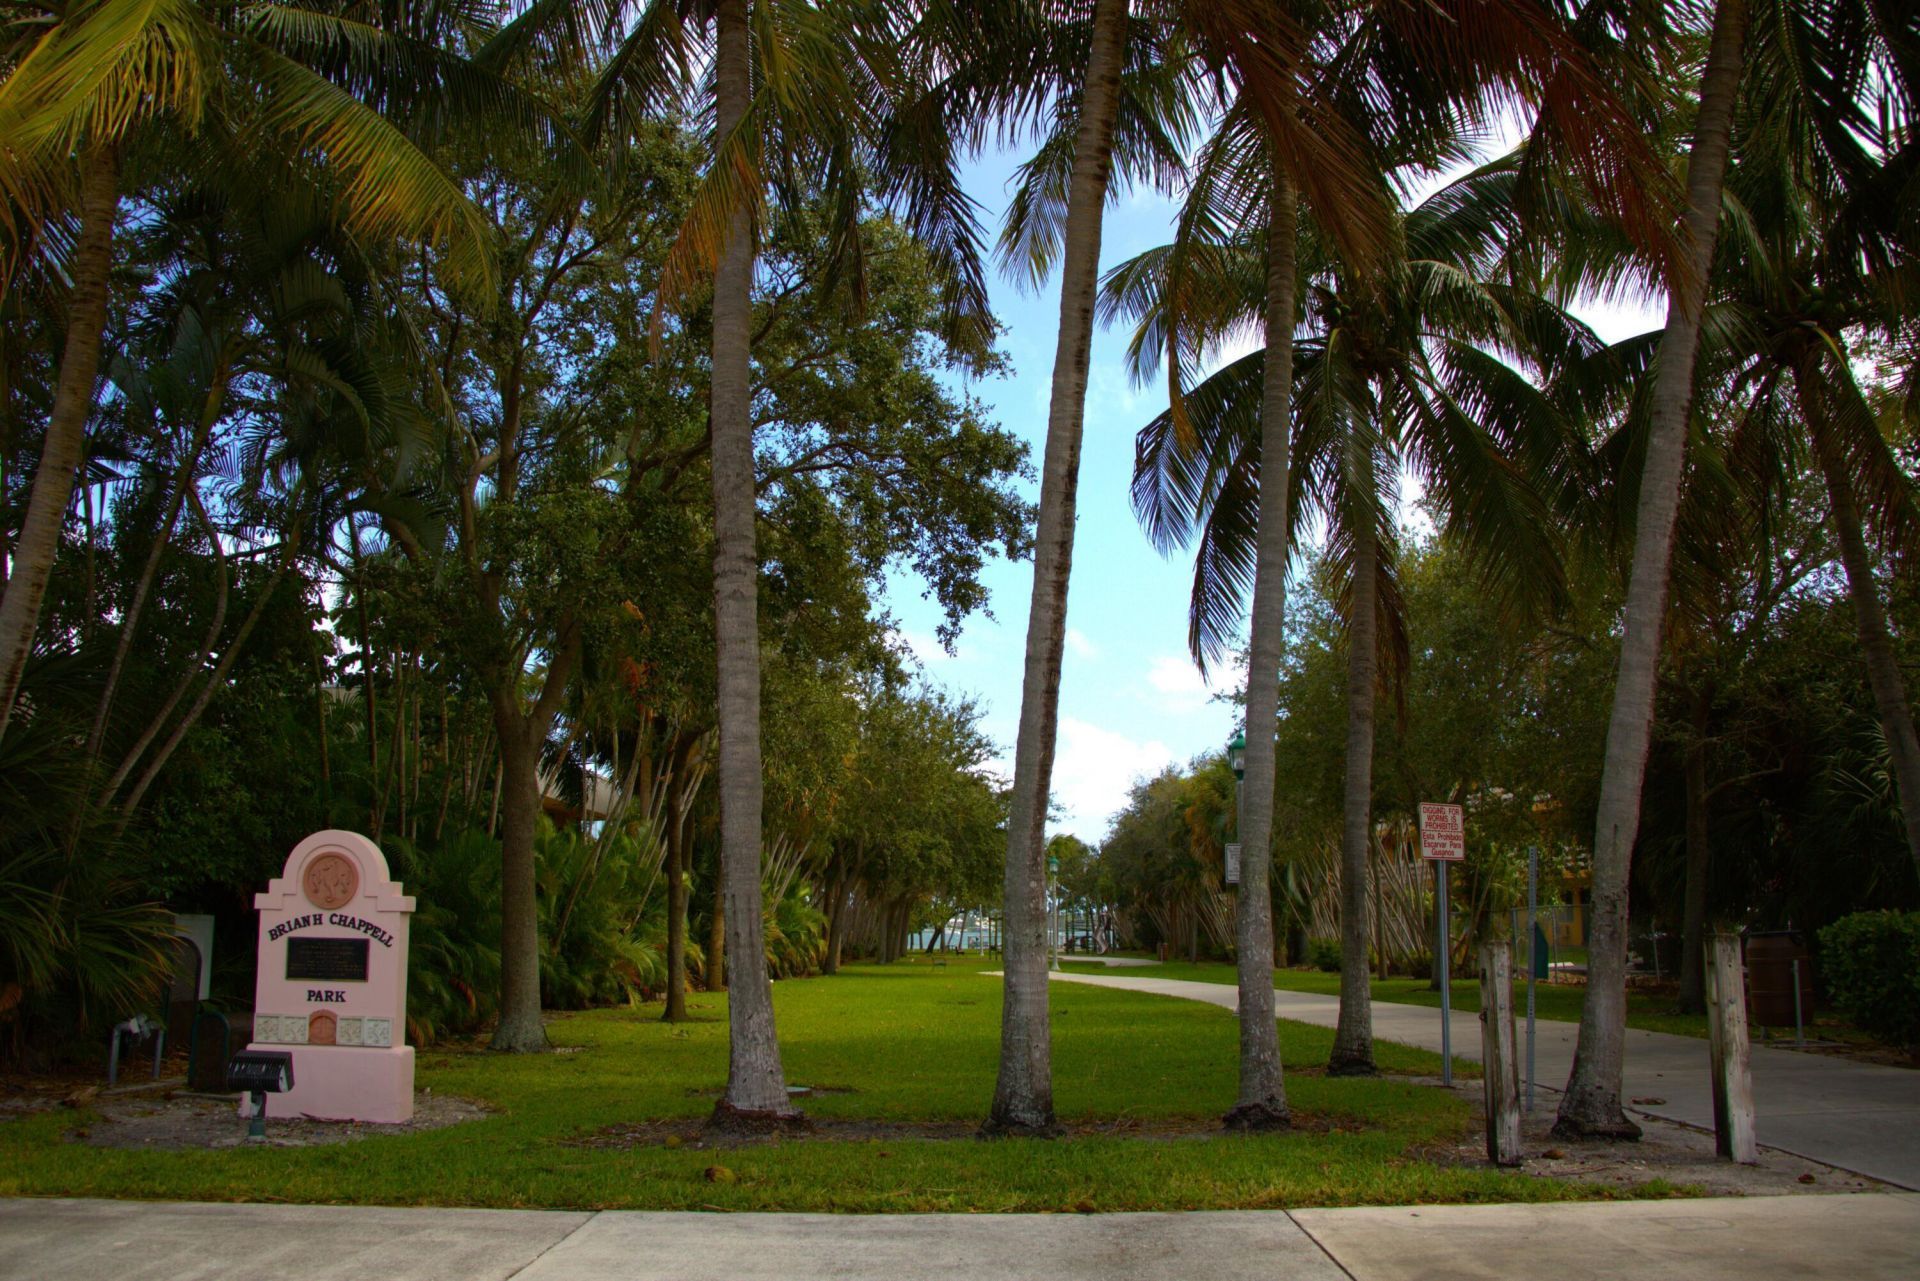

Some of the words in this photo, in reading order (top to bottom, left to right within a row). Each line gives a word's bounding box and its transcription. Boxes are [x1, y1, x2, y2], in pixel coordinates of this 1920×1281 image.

[1423, 806, 1445, 814] DIGGING
[1427, 814, 1448, 822] WORMS
[1450, 815, 1456, 823] IS
[1425, 822, 1458, 830] PROHIBITED
[1438, 832, 1462, 841] Prohibido
[1449, 840, 1461, 848] Para
[1432, 847, 1454, 856] Gusanos
[329, 913, 394, 948] CHAPPELL
[306, 989, 346, 1002] PARK
